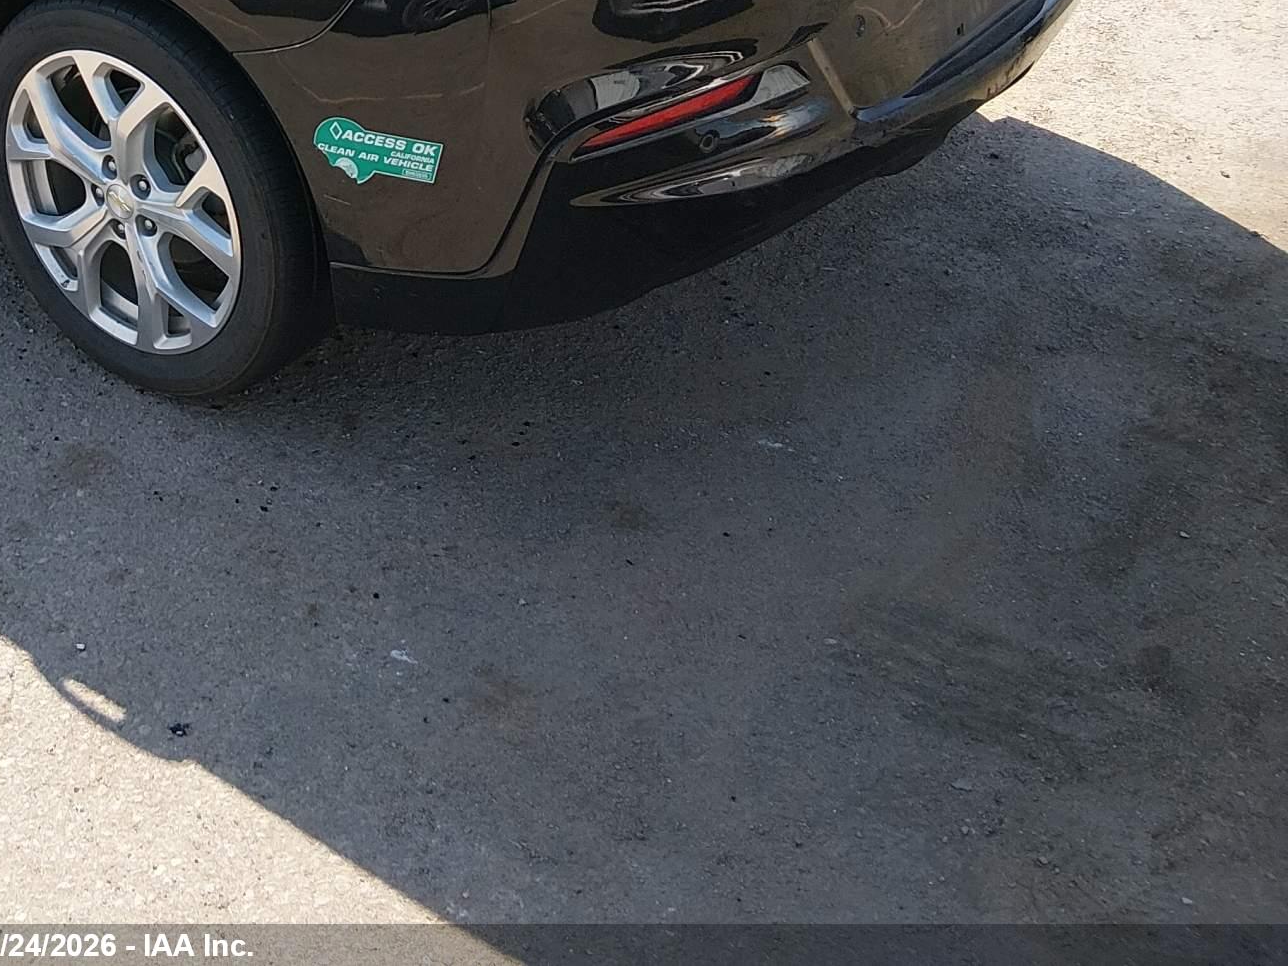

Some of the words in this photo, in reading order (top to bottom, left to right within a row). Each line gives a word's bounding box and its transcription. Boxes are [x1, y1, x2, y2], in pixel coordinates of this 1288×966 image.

[341, 129, 407, 151] ACCESS
[412, 142, 438, 156] OK
[317, 142, 356, 158] CLEAN
[358, 151, 379, 163] AIR
[383, 155, 435, 173] VEHICLE
[390, 150, 435, 163] CALIFORNIA
